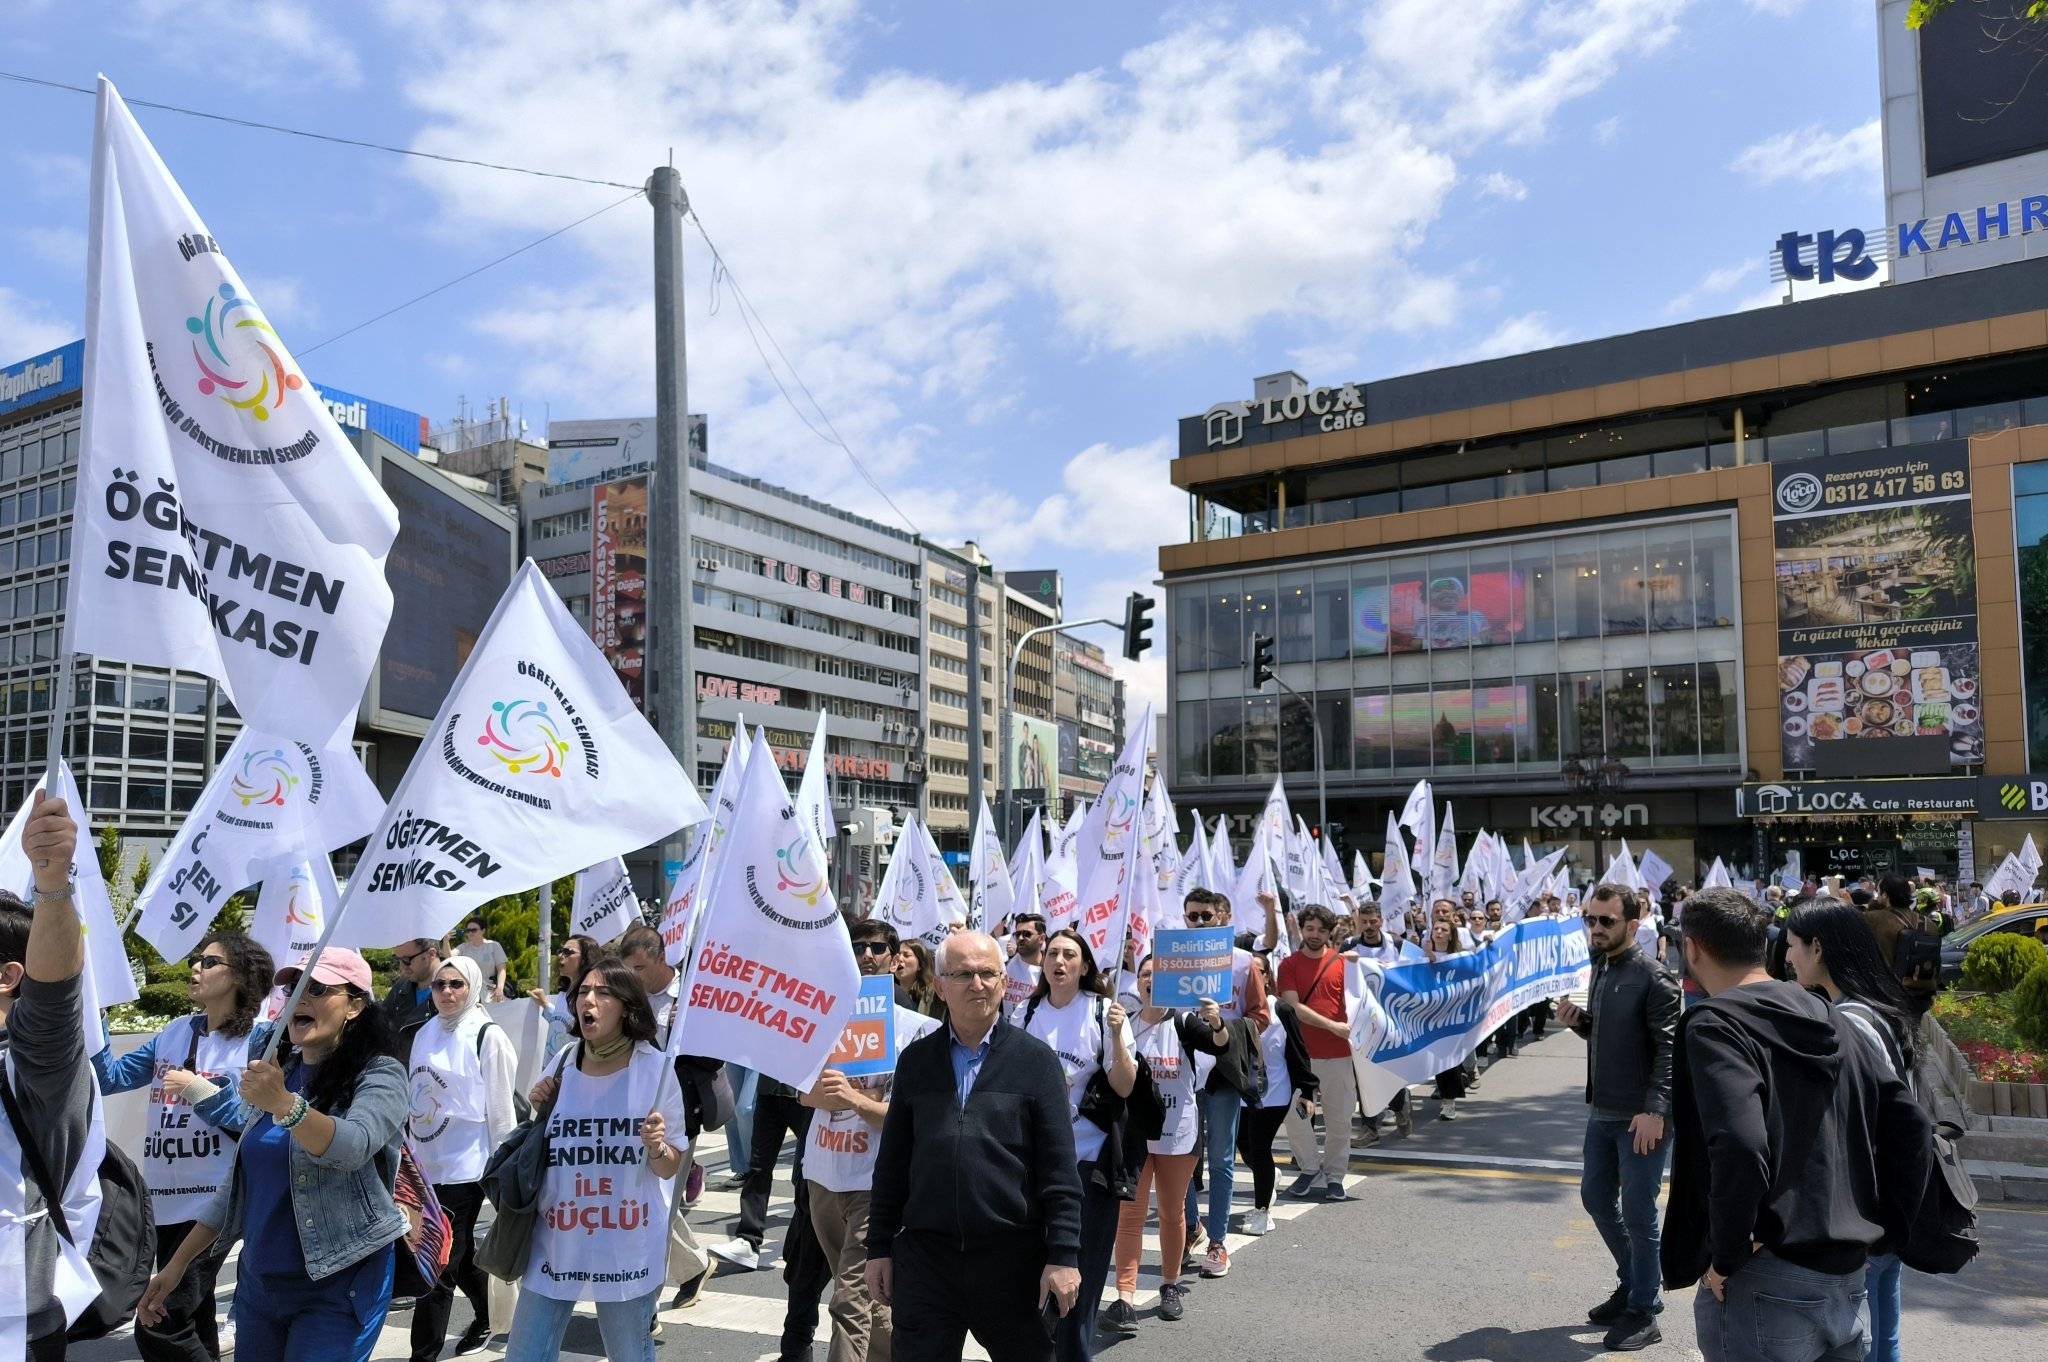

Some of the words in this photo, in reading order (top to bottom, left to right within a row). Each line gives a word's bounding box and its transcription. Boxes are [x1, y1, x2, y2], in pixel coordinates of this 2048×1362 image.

[1262, 382, 1365, 425] LOCA
[180, 415, 275, 465] ÖĞRETMENLERİ
[1825, 465, 1903, 483] Rezervasyon
[1906, 461, 1929, 475] İçin
[1825, 483, 1869, 504] 0312
[1873, 477, 1907, 498] 417
[1912, 474, 1936, 493] 56
[1941, 470, 1965, 490] 63
[596, 500, 611, 653] ezervasyon
[763, 558, 865, 604] TUSEM
[1810, 627, 1843, 645] güzel
[1845, 624, 1876, 638] vakit
[1880, 619, 1963, 637] geçireceğiniz
[1855, 637, 1898, 649] Mekan
[697, 674, 738, 700] LOVE
[741, 682, 781, 706] SHOP
[517, 660, 575, 716] ÖĞRETMEN
[571, 716, 600, 780] SENDİKASI
[448, 754, 507, 795] ÖĞRETMENLERİ
[505, 788, 553, 810] SENDİKASI
[1797, 790, 1868, 811] LOCA
[1872, 799, 1900, 811] Cafe
[1908, 797, 1975, 809] Restaurant
[761, 904, 814, 930] ÖĞRETMENLERİ
[698, 939, 836, 1016] ÖĞRETMEN
[1178, 973, 1222, 996] SON!
[688, 982, 818, 1044] SENDİKASI
[161, 1106, 192, 1129] İLE
[144, 1130, 221, 1164] GÜÇLÜ!
[177, 1185, 217, 1195] SENDİKASI
[575, 1172, 613, 1198] İLE
[592, 1267, 649, 1282] SENDİKASI
